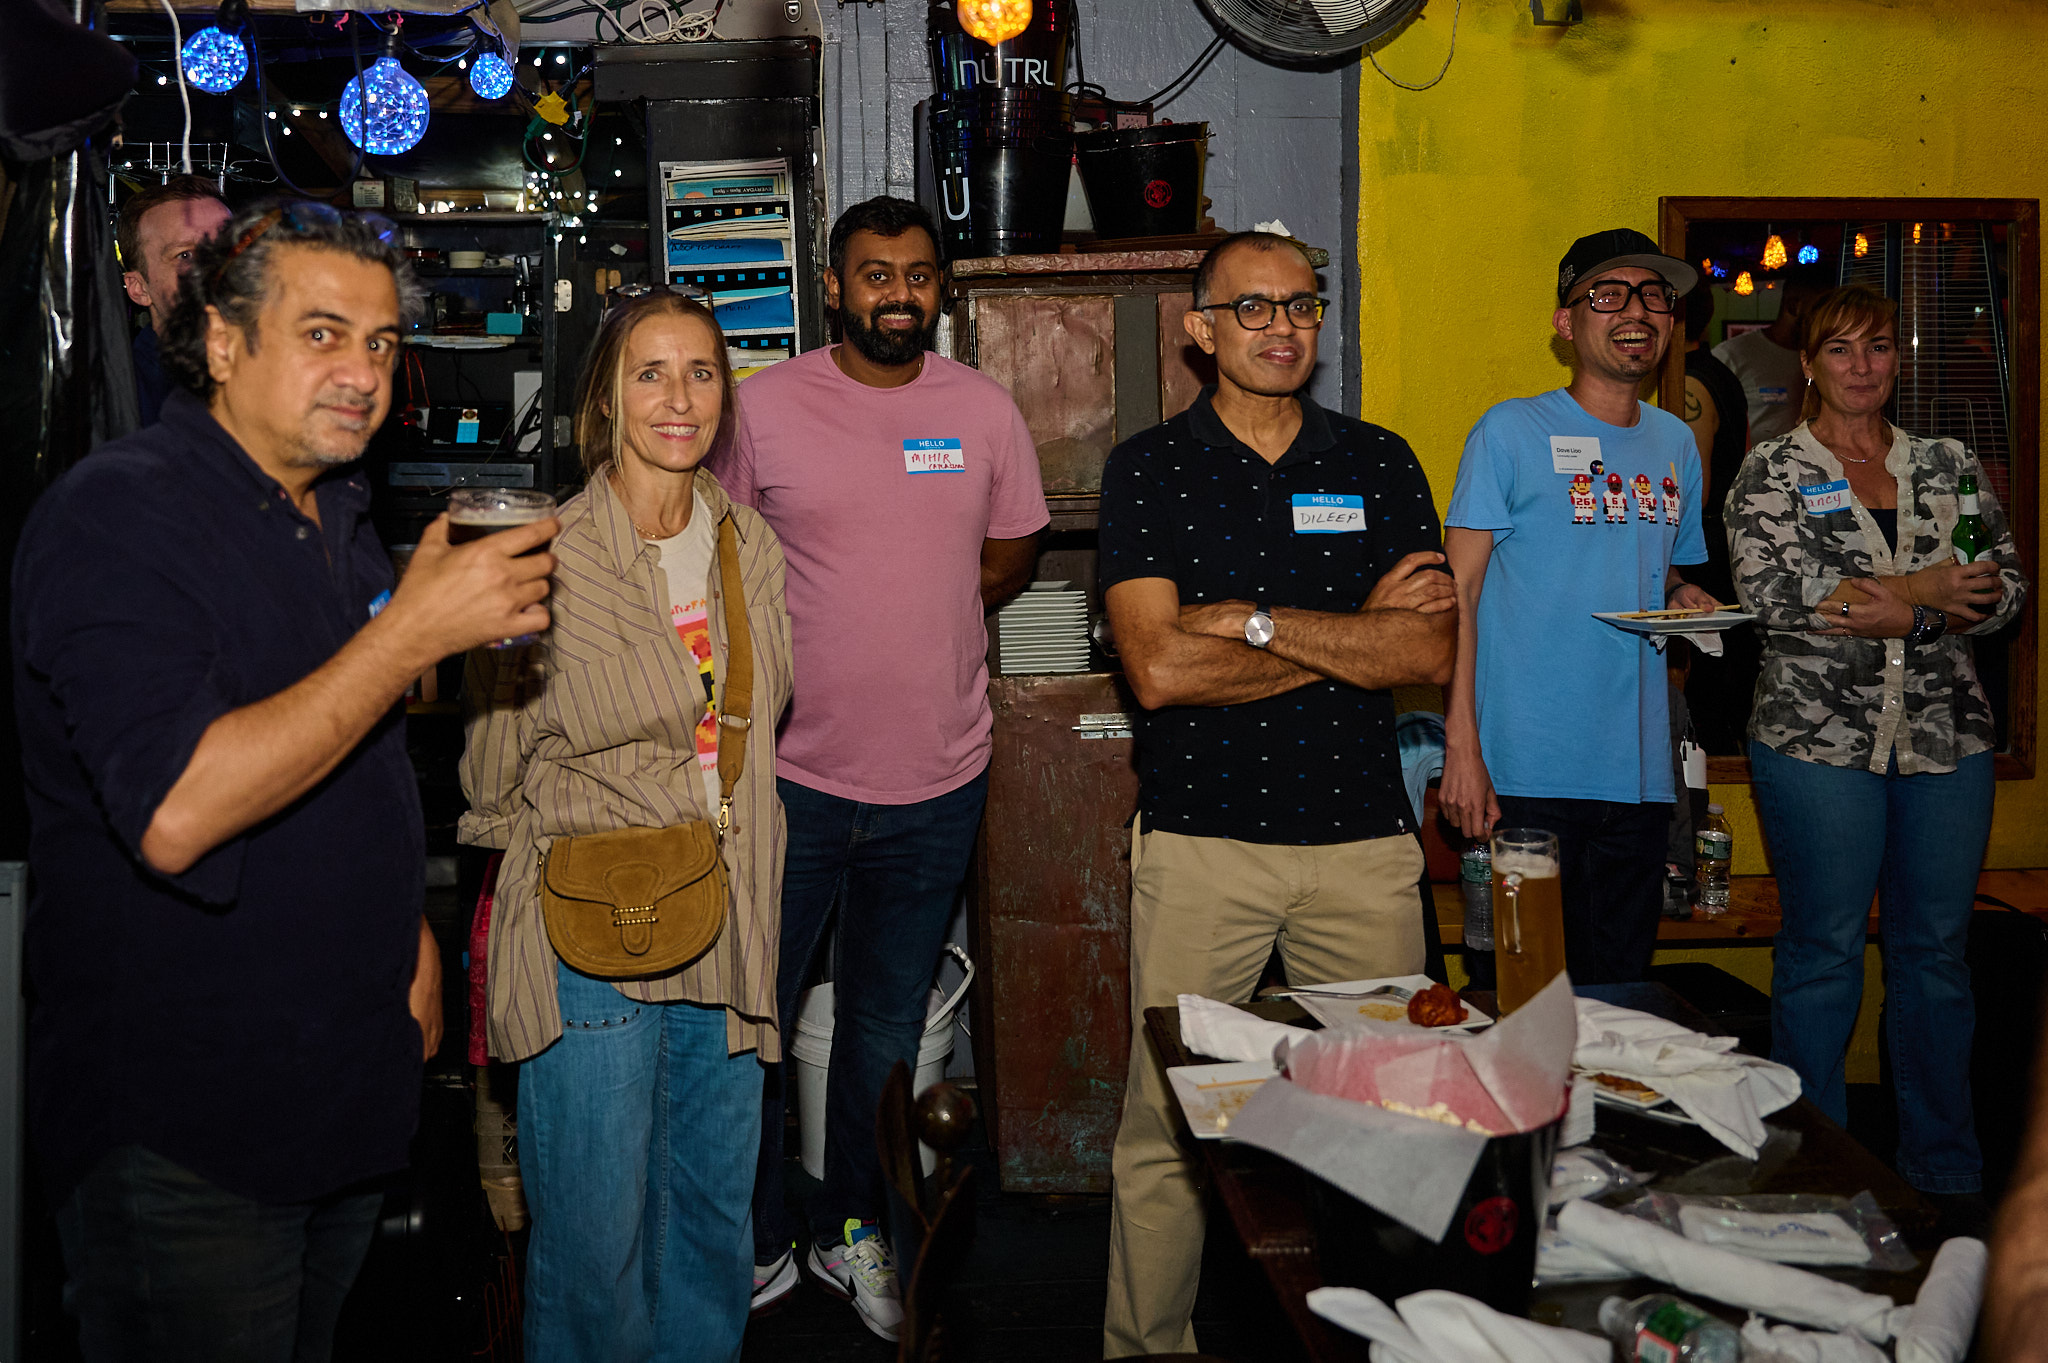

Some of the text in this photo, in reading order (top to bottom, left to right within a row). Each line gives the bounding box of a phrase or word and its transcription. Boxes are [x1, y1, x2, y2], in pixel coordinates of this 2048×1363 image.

[911, 452, 952, 464] MIHIR
[1806, 484, 1833, 493] HELLO
[1312, 496, 1344, 504] HELLO
[1300, 511, 1358, 525] DILEEP
